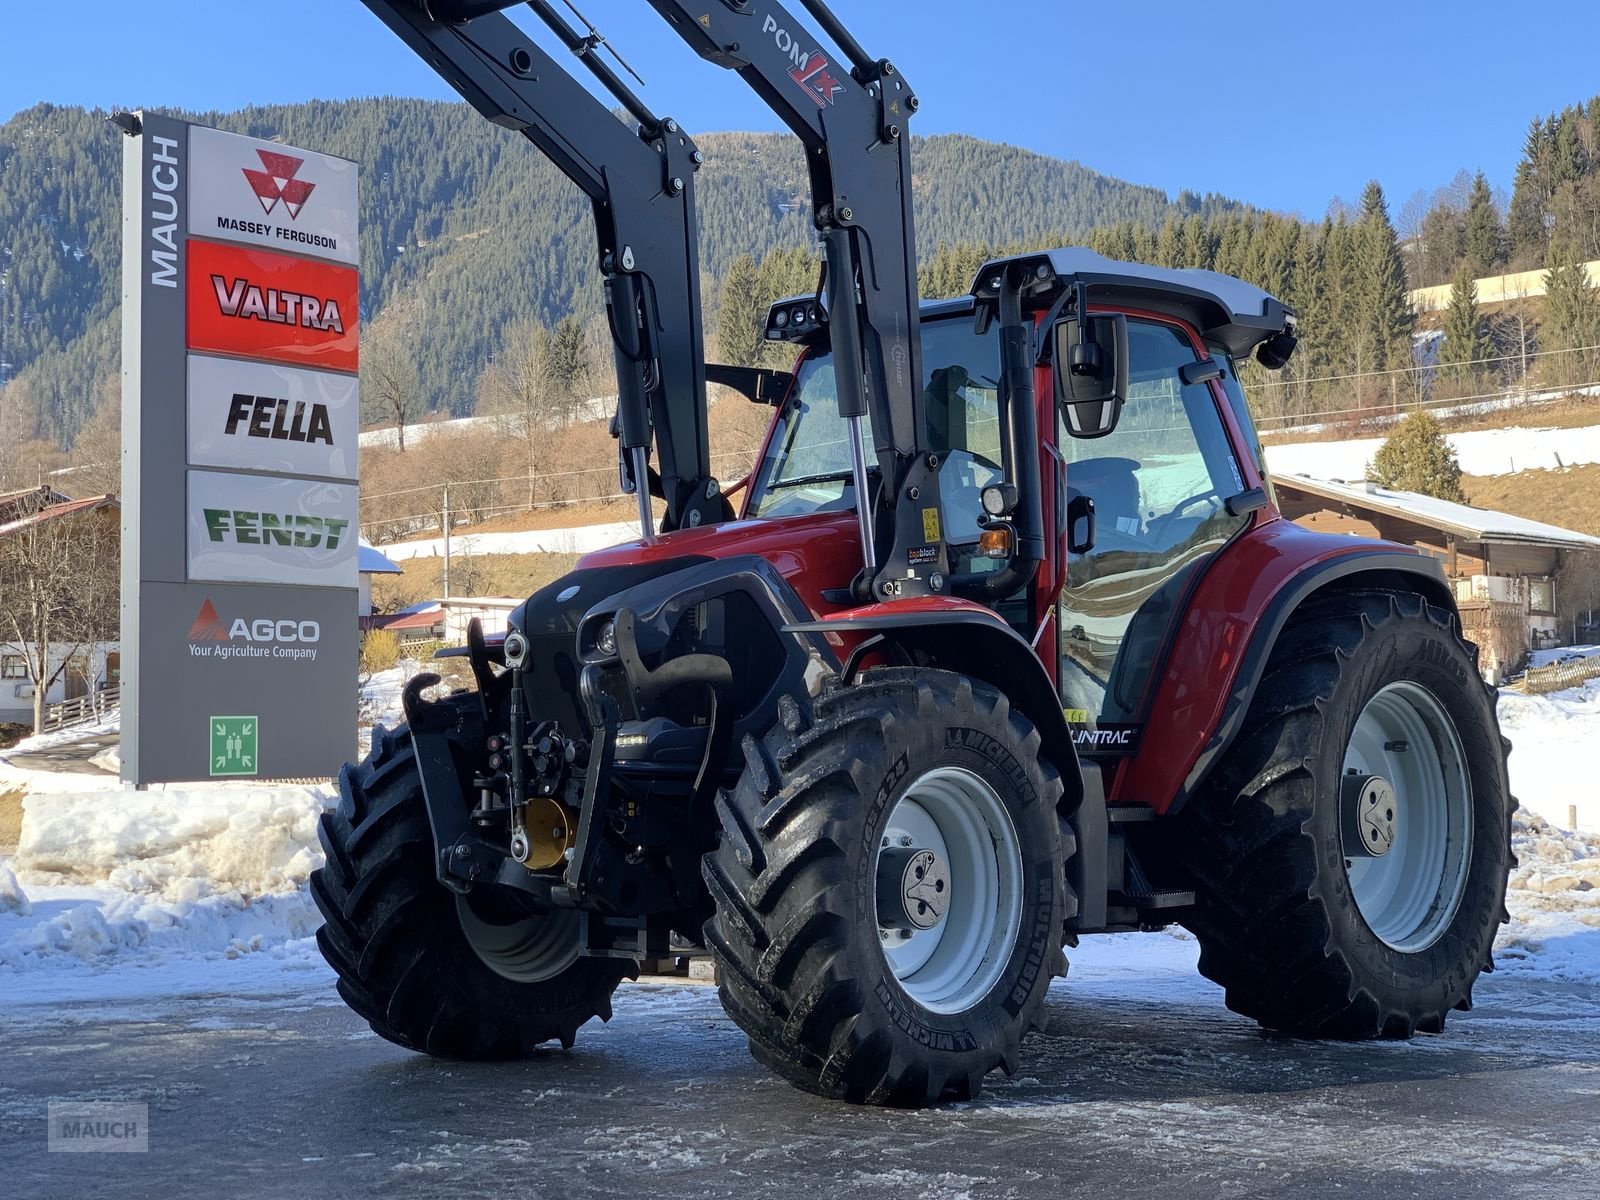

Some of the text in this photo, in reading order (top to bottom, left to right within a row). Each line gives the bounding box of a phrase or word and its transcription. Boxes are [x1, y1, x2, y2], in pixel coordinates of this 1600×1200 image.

[152, 136, 178, 288] MAUCH
[217, 216, 337, 250] MASSEY FERGUSON
[210, 274, 345, 335] VALTRA
[224, 393, 334, 446] FELLA
[203, 508, 349, 550] FENDT
[189, 644, 317, 660] Your Agriculture Company
[229, 618, 320, 642] AGCO
[1071, 730, 1131, 744] LINTRAC
[965, 729, 1036, 802] MICHELIN
[1013, 878, 1052, 1006] MULTIBIB
[875, 984, 954, 1050] MICHELIN
